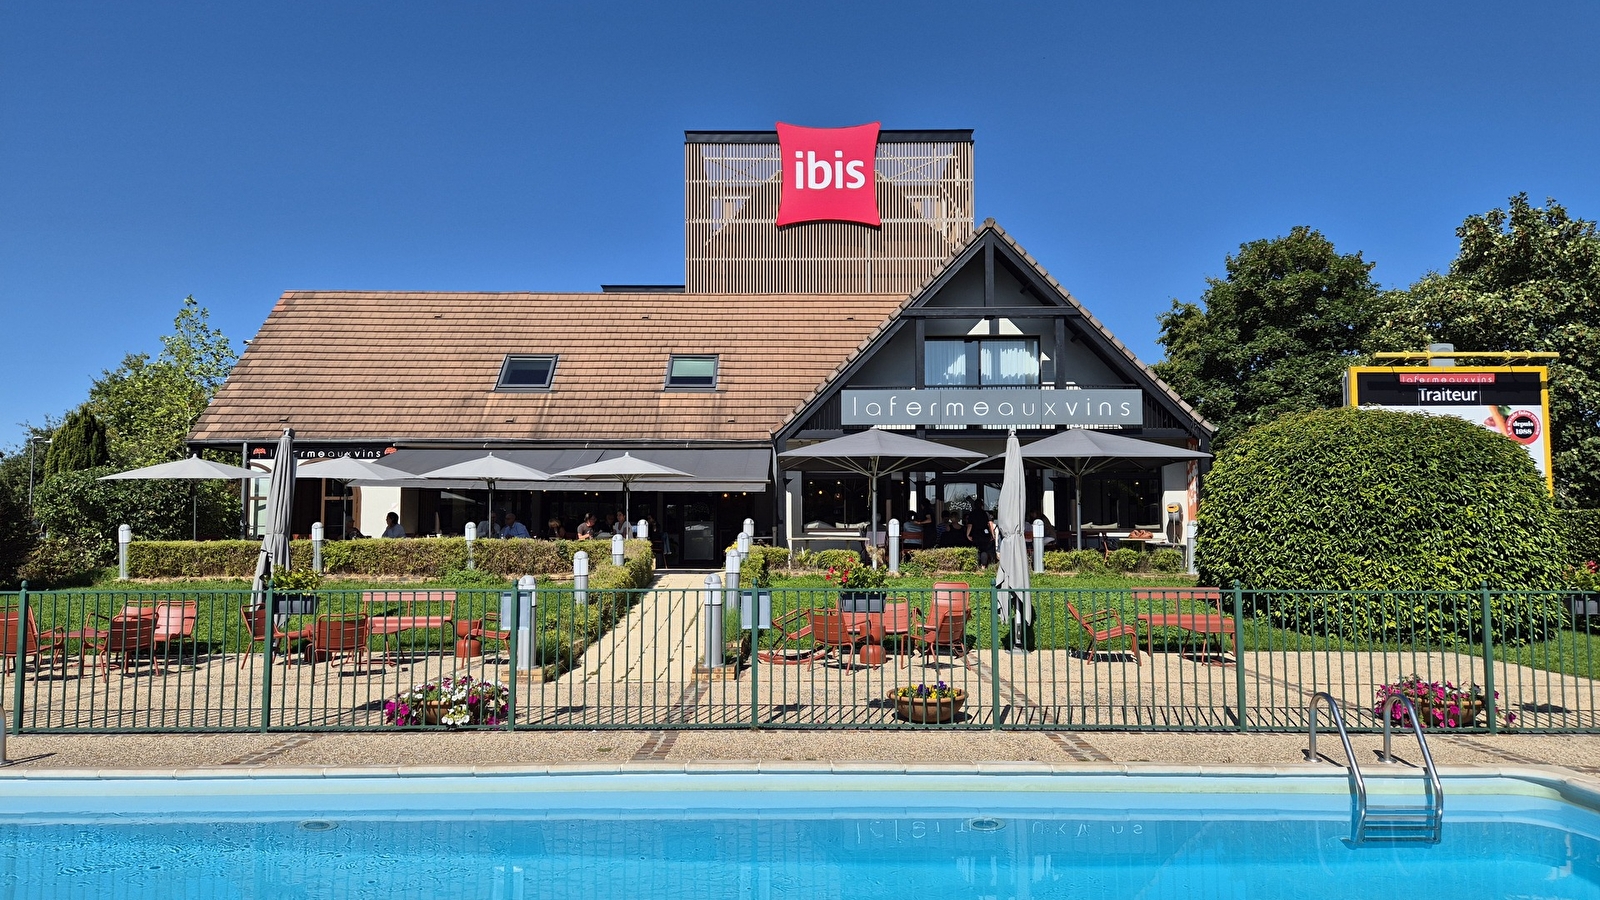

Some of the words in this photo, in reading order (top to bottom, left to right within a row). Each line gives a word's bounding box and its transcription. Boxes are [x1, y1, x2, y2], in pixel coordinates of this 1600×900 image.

[795, 150, 866, 190] ibis
[1418, 387, 1478, 402] Traiteur
[852, 396, 1131, 417] lafermeauxvins
